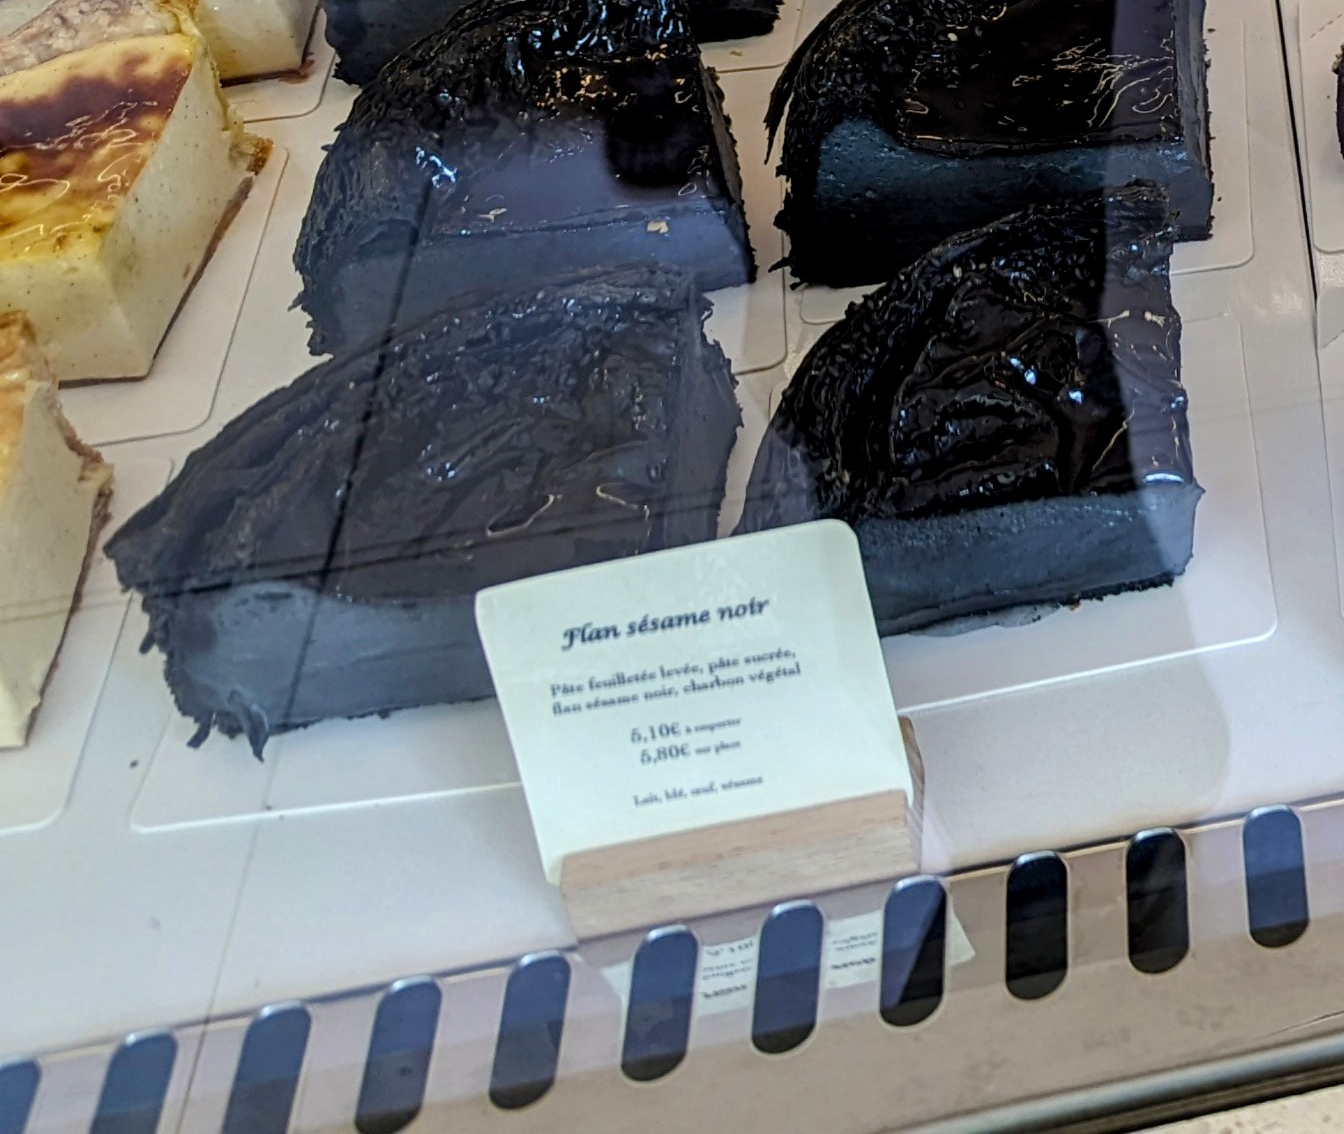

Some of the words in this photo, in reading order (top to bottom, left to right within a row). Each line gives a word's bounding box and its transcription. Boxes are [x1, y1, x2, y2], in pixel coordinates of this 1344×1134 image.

[561, 622, 621, 651] Flan
[626, 609, 711, 637] sésame
[716, 596, 770, 622] noir
